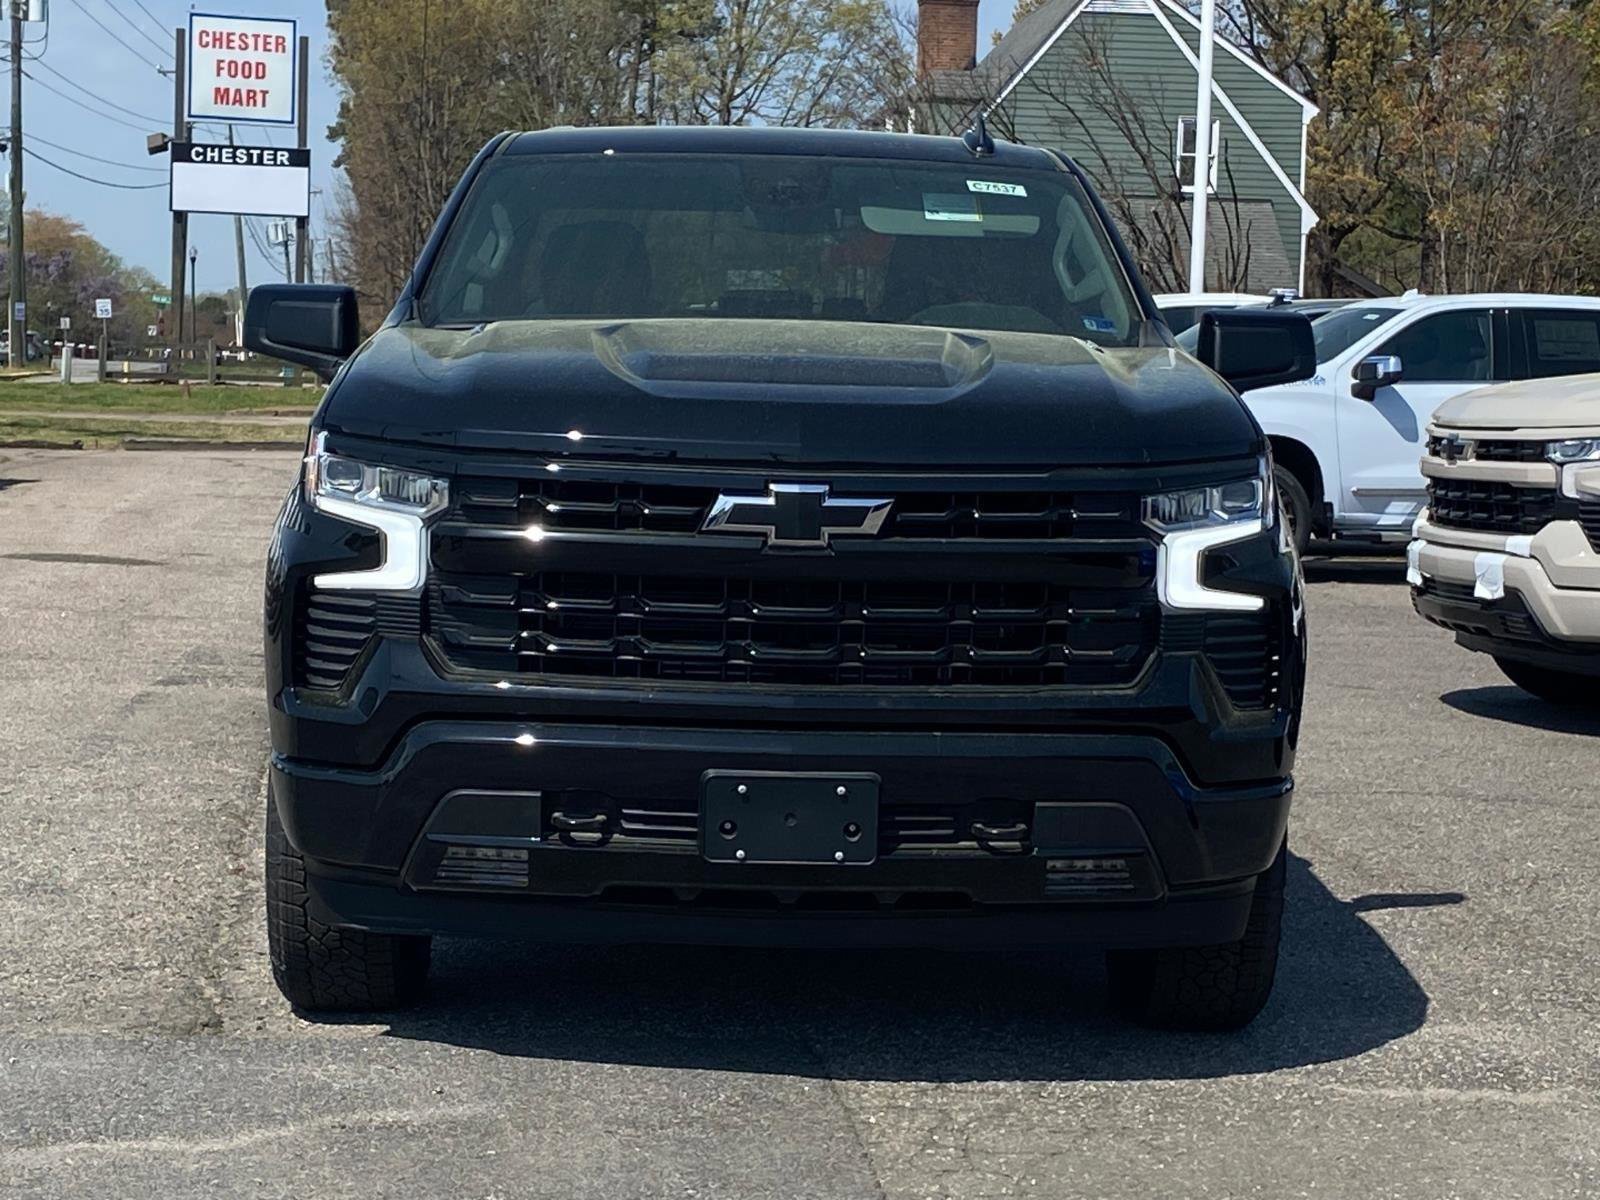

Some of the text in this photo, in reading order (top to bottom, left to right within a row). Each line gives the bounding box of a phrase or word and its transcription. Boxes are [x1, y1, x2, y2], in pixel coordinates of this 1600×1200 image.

[198, 29, 286, 53] CHESTER
[216, 59, 266, 80] FOOD
[214, 87, 269, 108] MART
[191, 146, 290, 165] CHESTER
[973, 182, 1016, 193] C7537
